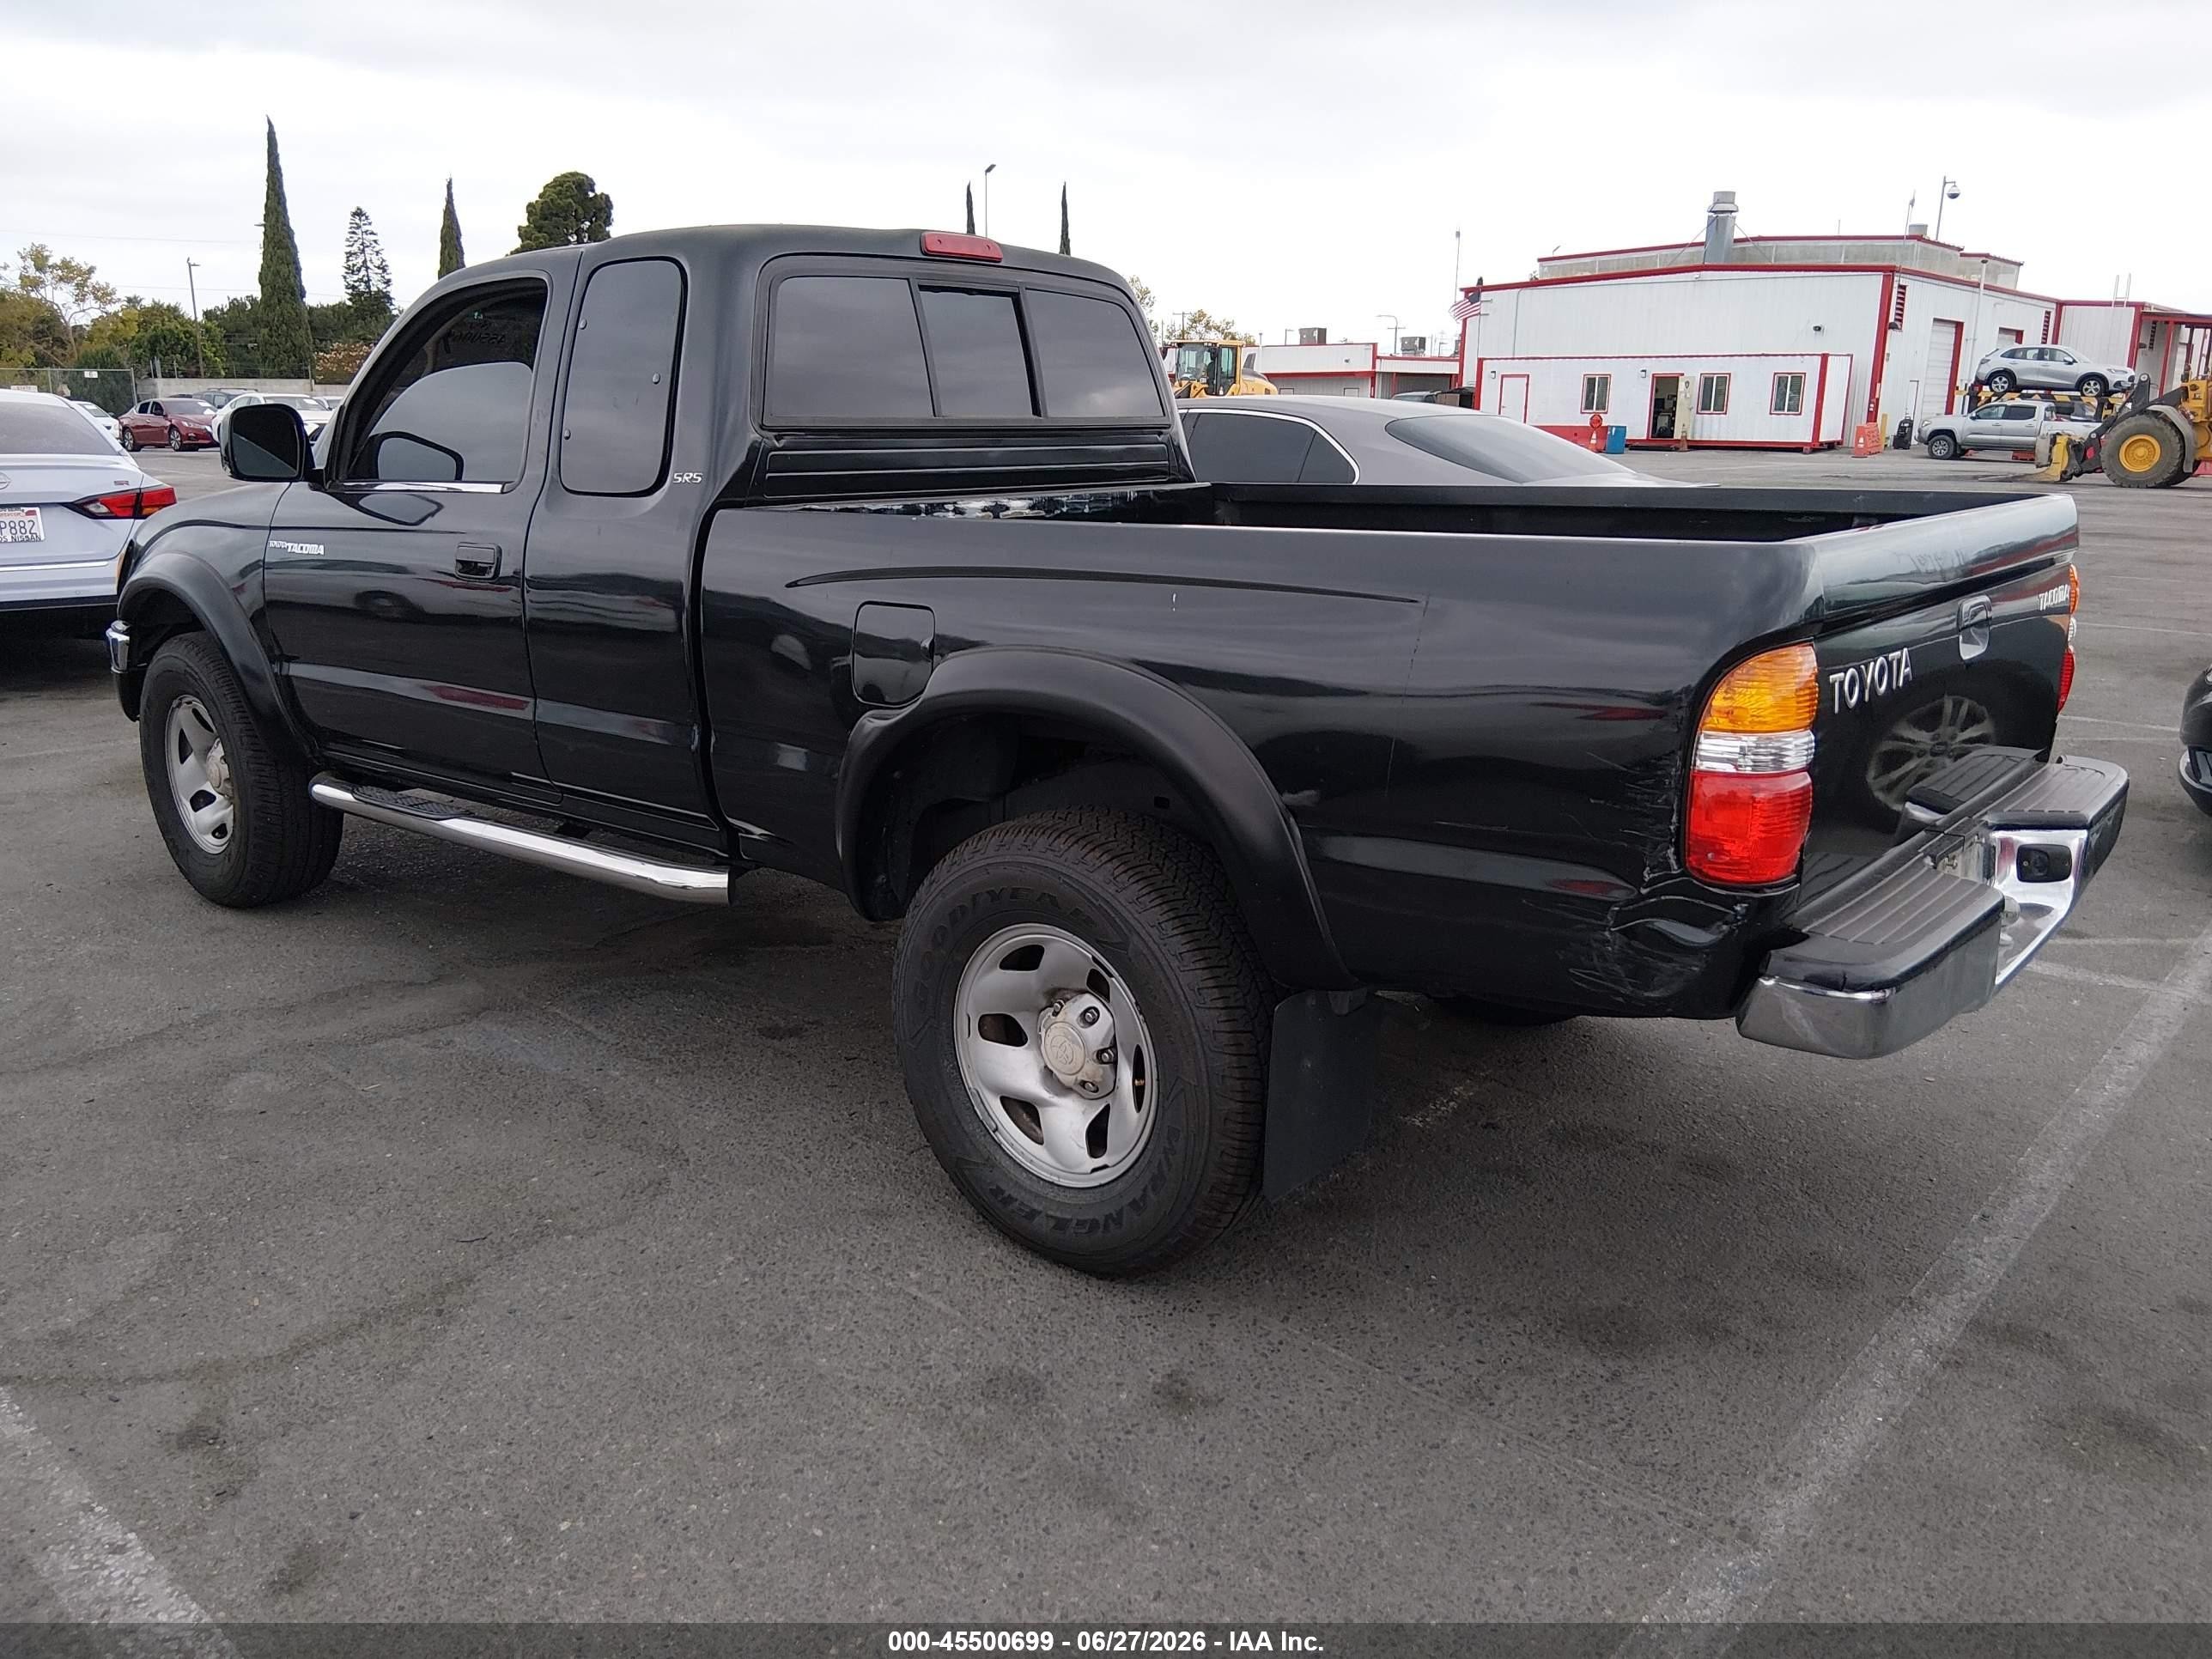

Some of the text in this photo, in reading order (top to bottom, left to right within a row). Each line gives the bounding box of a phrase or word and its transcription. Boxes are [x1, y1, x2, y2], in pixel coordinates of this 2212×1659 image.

[672, 471, 703, 483] SR5
[286, 542, 325, 556] TACOMA
[2039, 583, 2070, 611] TACOMA
[1829, 647, 1912, 714] TOYOTA
